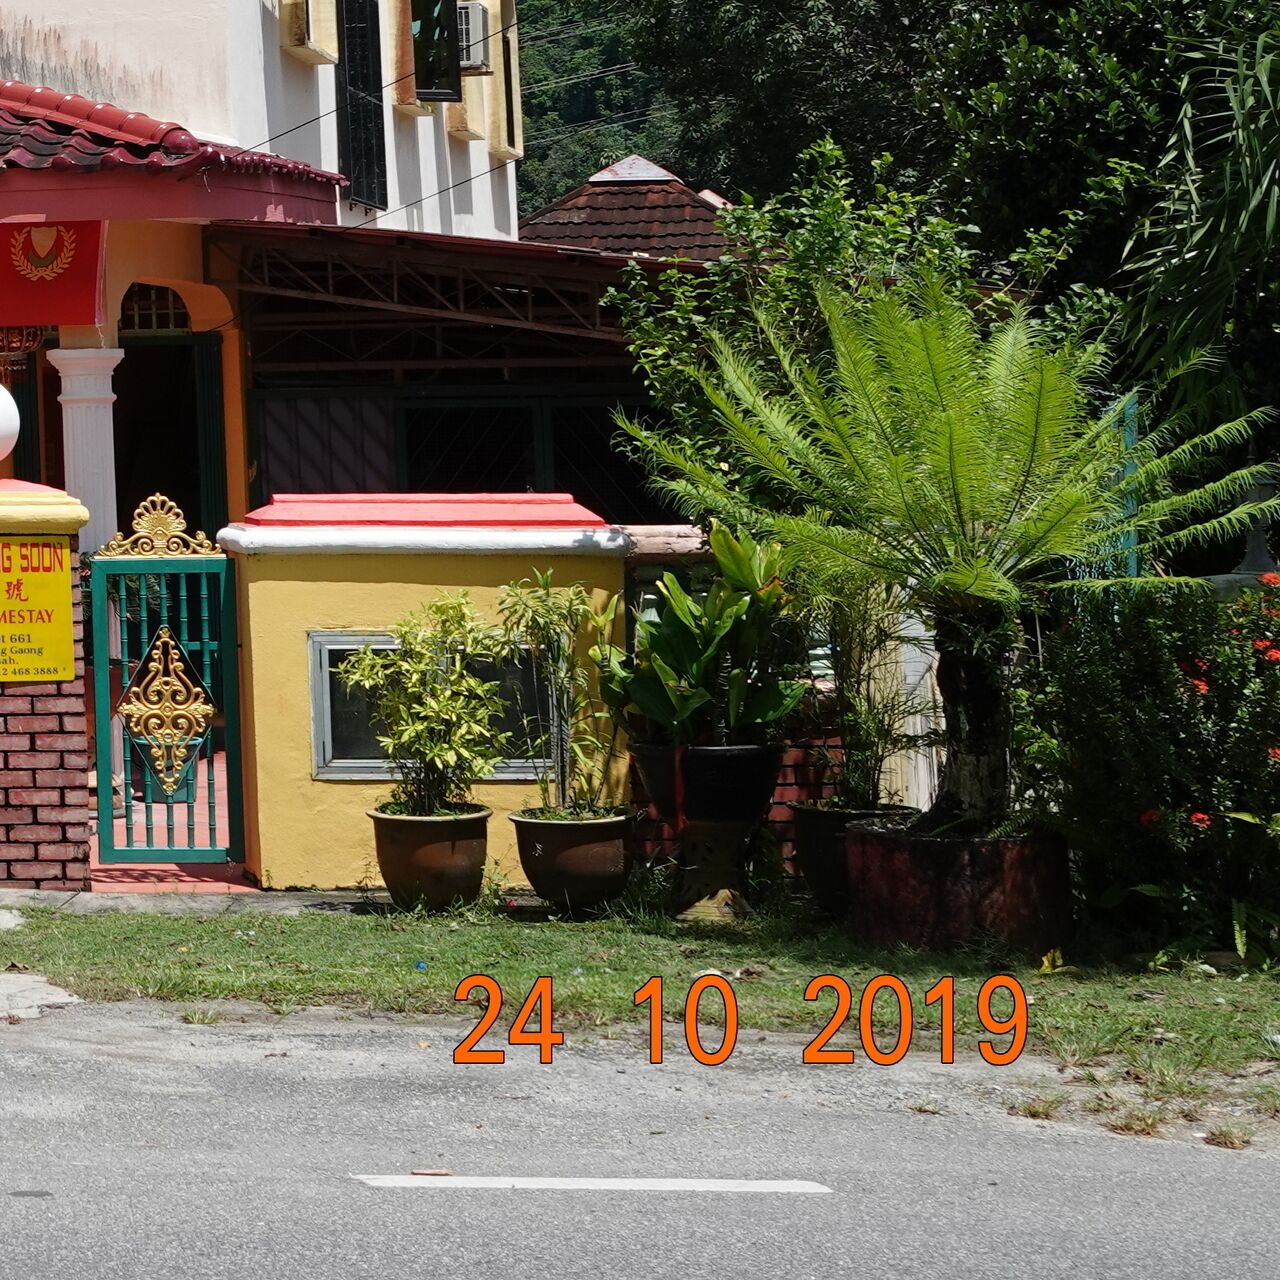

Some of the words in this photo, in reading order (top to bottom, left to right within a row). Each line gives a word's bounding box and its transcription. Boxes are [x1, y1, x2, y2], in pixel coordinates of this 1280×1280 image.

[19, 542, 64, 573] SOON
[10, 634, 32, 644] 661
[10, 646, 44, 656] Gaong
[11, 667, 30, 676] 468
[33, 667, 59, 676] 3888
